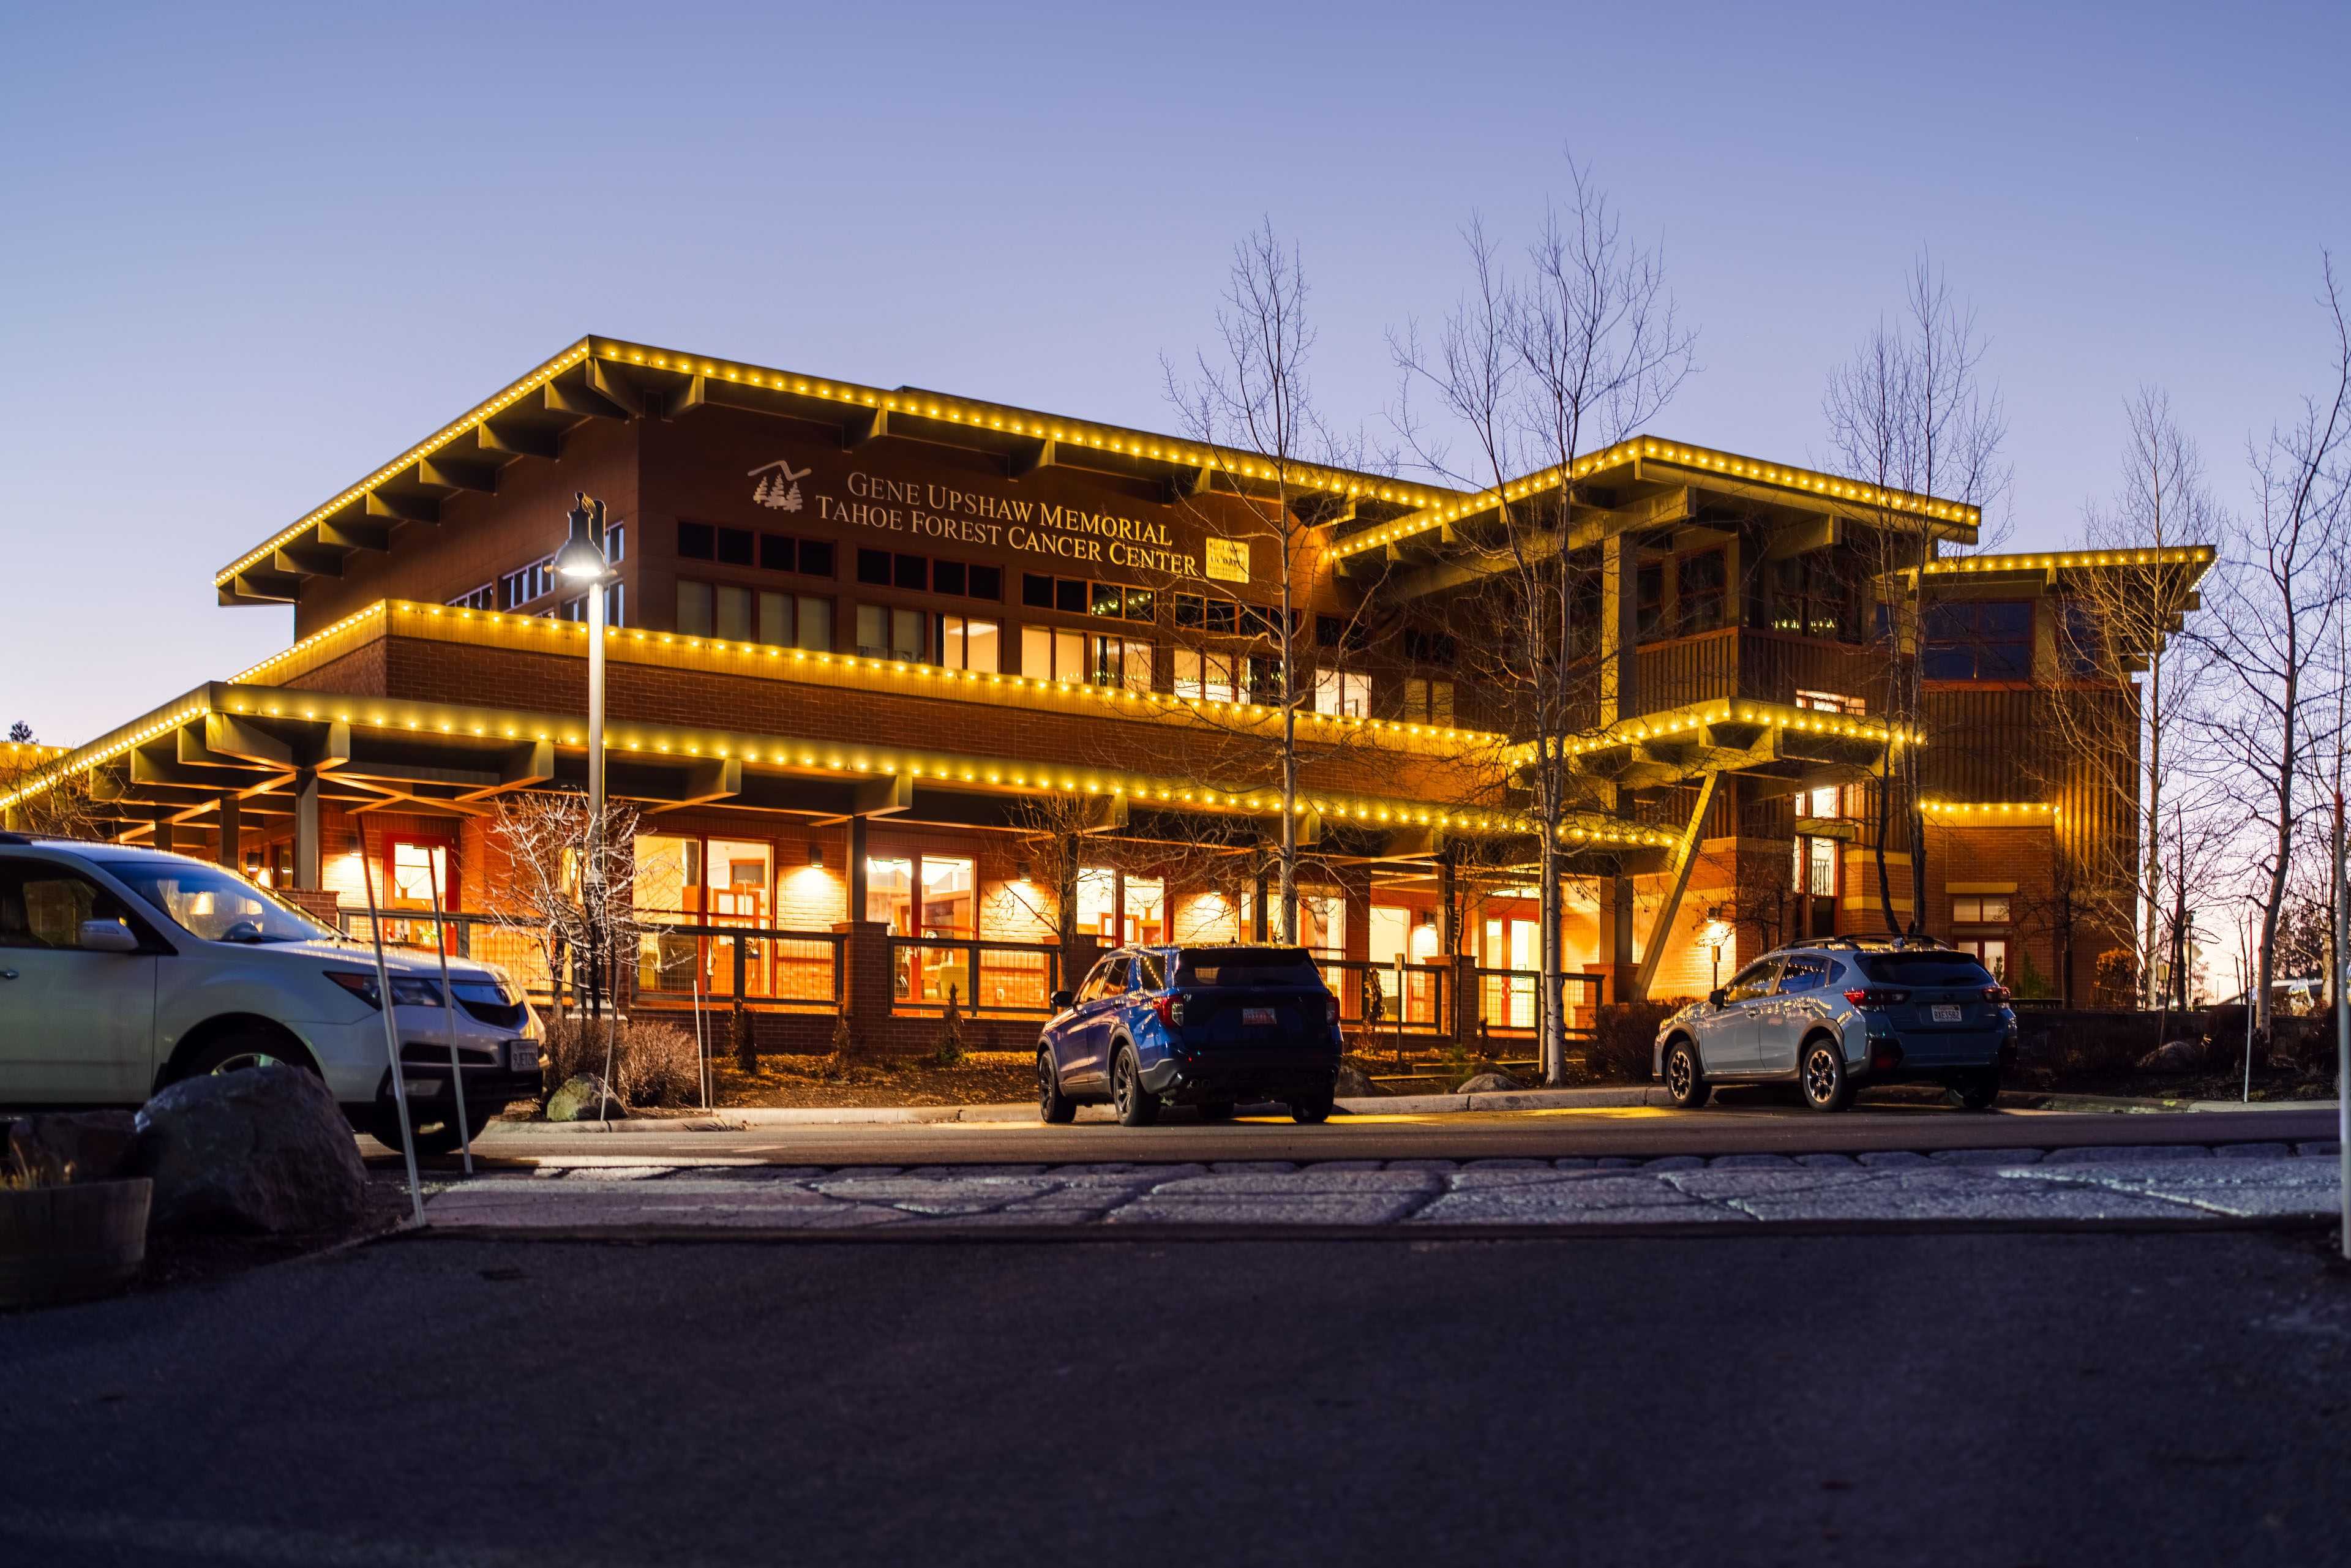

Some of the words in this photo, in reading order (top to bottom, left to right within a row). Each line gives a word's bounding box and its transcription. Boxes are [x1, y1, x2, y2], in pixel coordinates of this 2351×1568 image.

[815, 494, 903, 531] TAHOE
[910, 509, 1002, 546] FOREST
[1008, 525, 1103, 563] CANCER
[1109, 541, 1198, 577] CENTER
[847, 471, 920, 506] GENE
[927, 484, 1033, 523] UPSHAW
[1038, 502, 1173, 547] MEMORIAL
